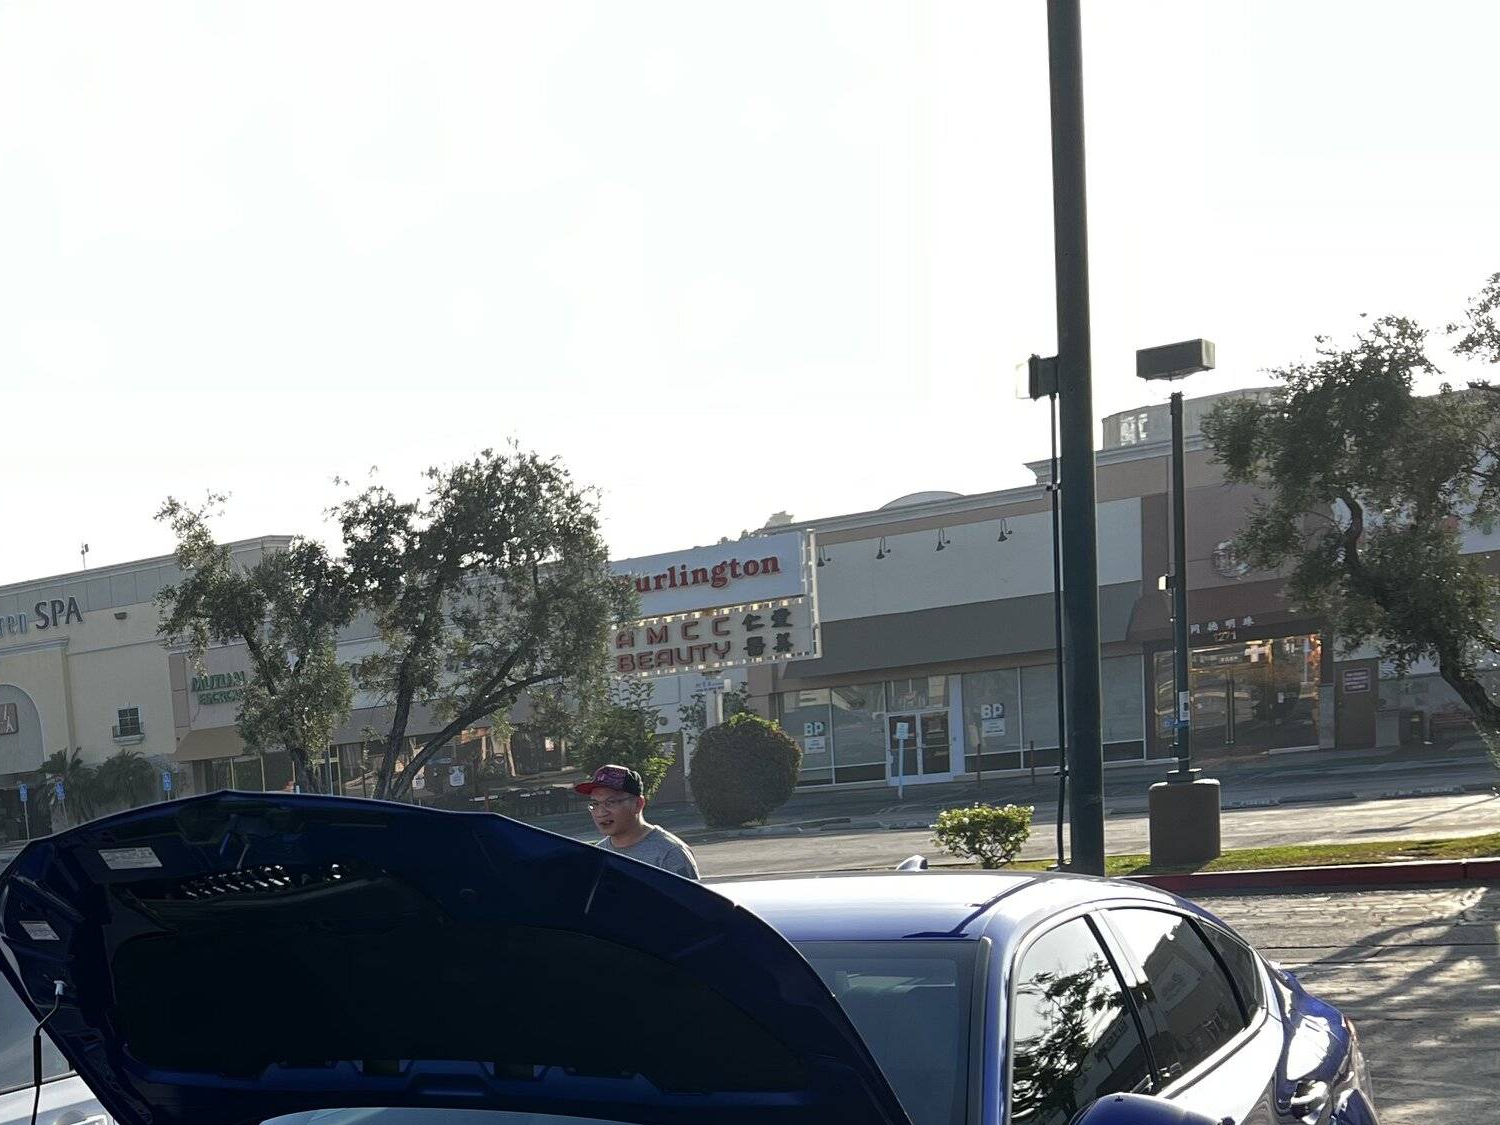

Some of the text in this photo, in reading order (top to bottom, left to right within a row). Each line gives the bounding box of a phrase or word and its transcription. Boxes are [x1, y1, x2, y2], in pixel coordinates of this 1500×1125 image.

[615, 555, 782, 593] urlington
[34, 595, 84, 632] SPA
[615, 641, 731, 673] BEAUTY
